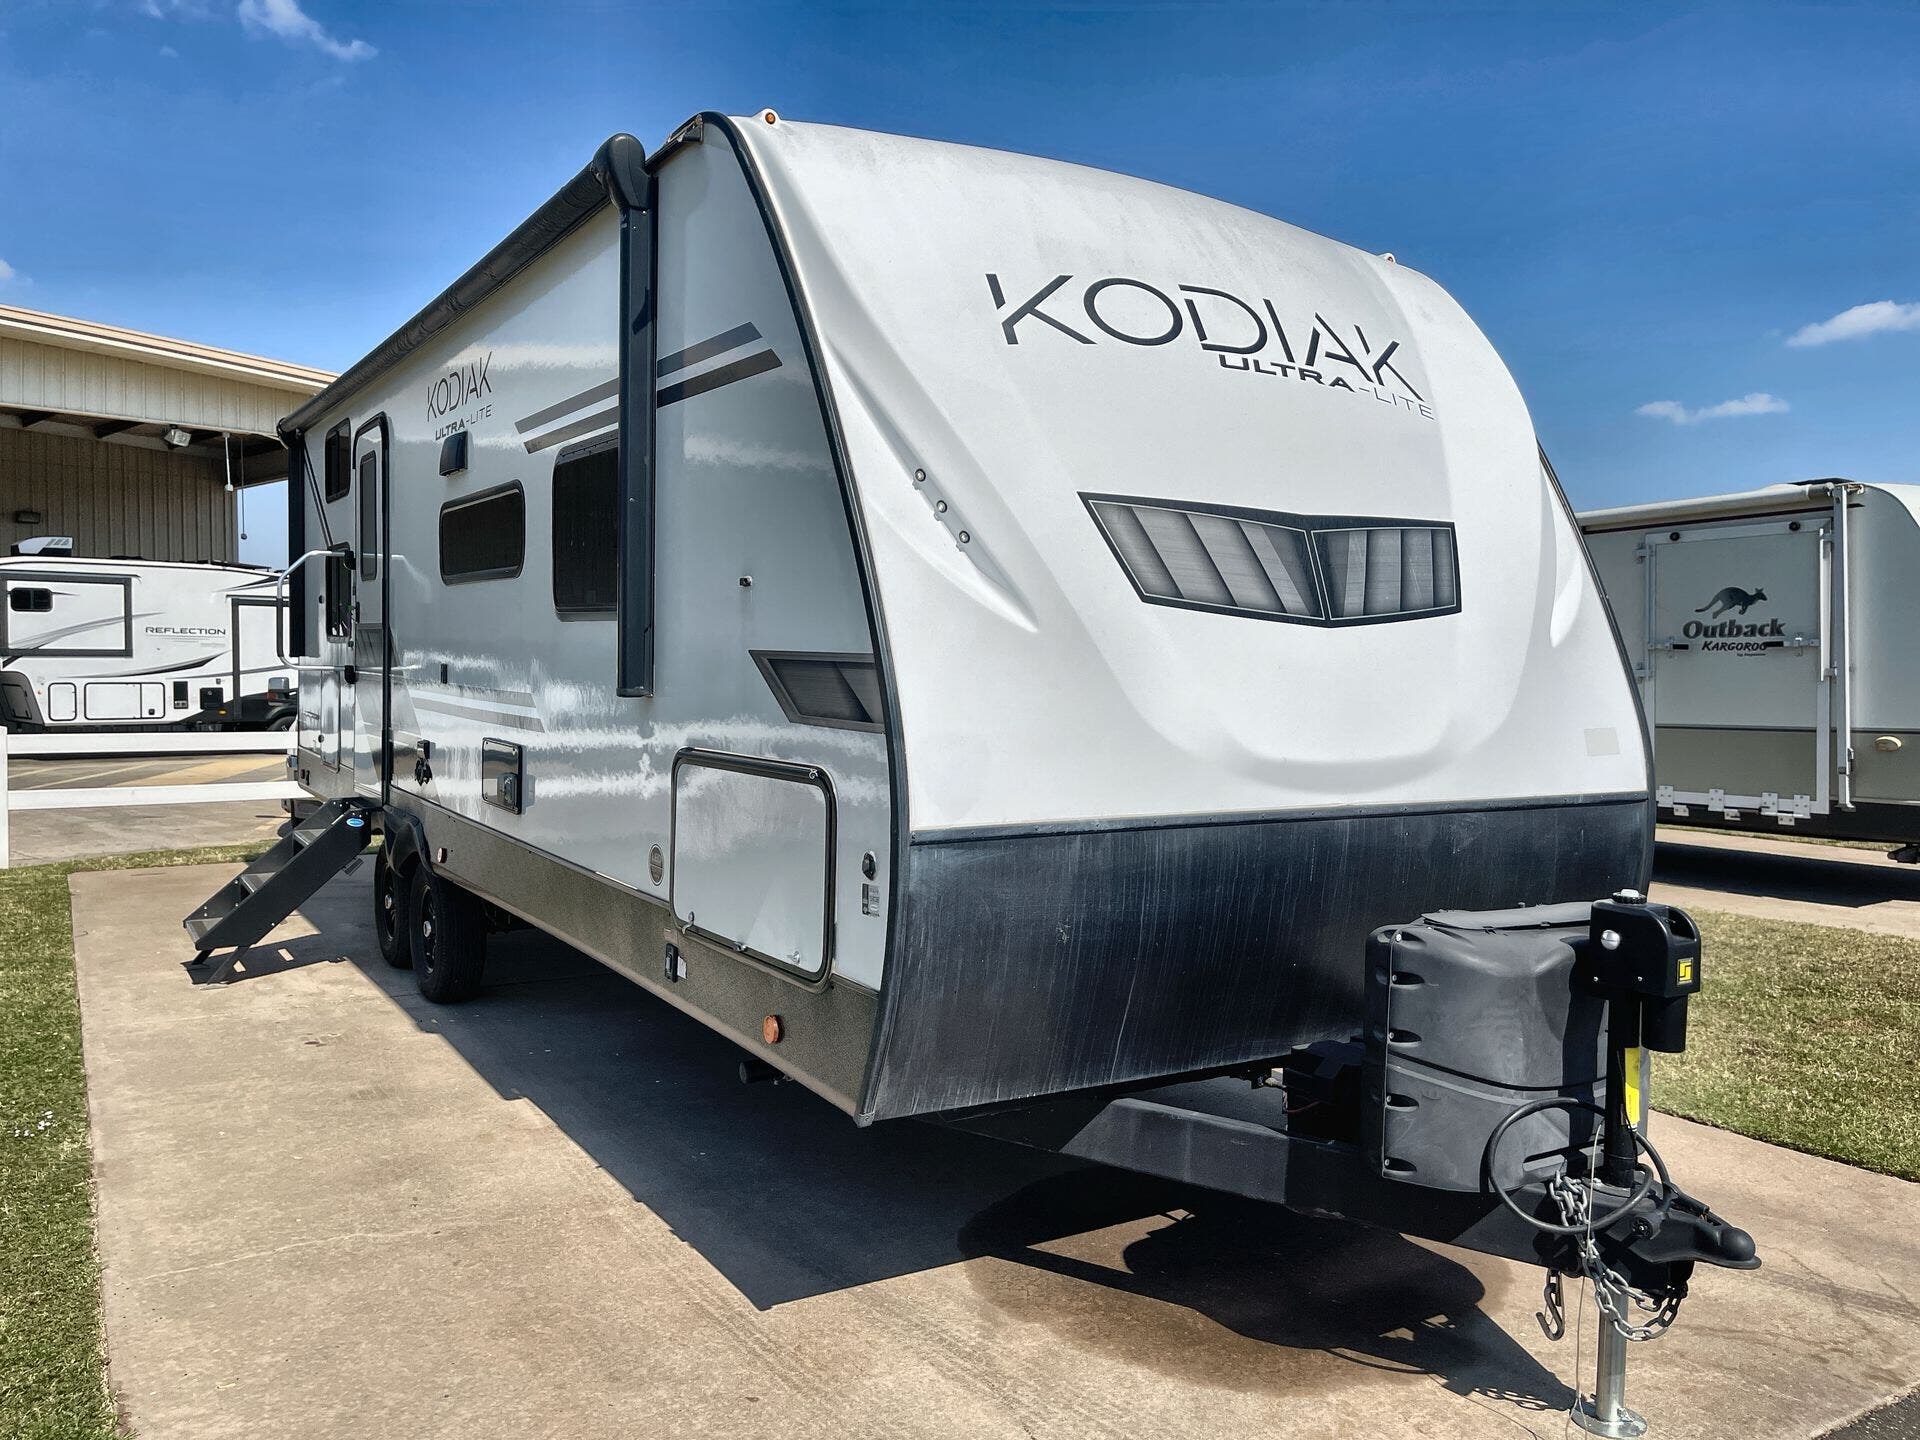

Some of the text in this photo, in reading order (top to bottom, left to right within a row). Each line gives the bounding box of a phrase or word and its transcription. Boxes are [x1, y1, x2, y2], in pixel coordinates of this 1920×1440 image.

[985, 273, 1425, 401] KODIAK
[427, 351, 492, 422] KODIAK
[1219, 354, 1434, 420] ULTRA-LITE
[435, 404, 492, 441] ULTRA-LITE
[145, 626, 226, 635] REFLECTION
[1683, 618, 1786, 639] Outback
[1701, 641, 1767, 651] KARGOROO
